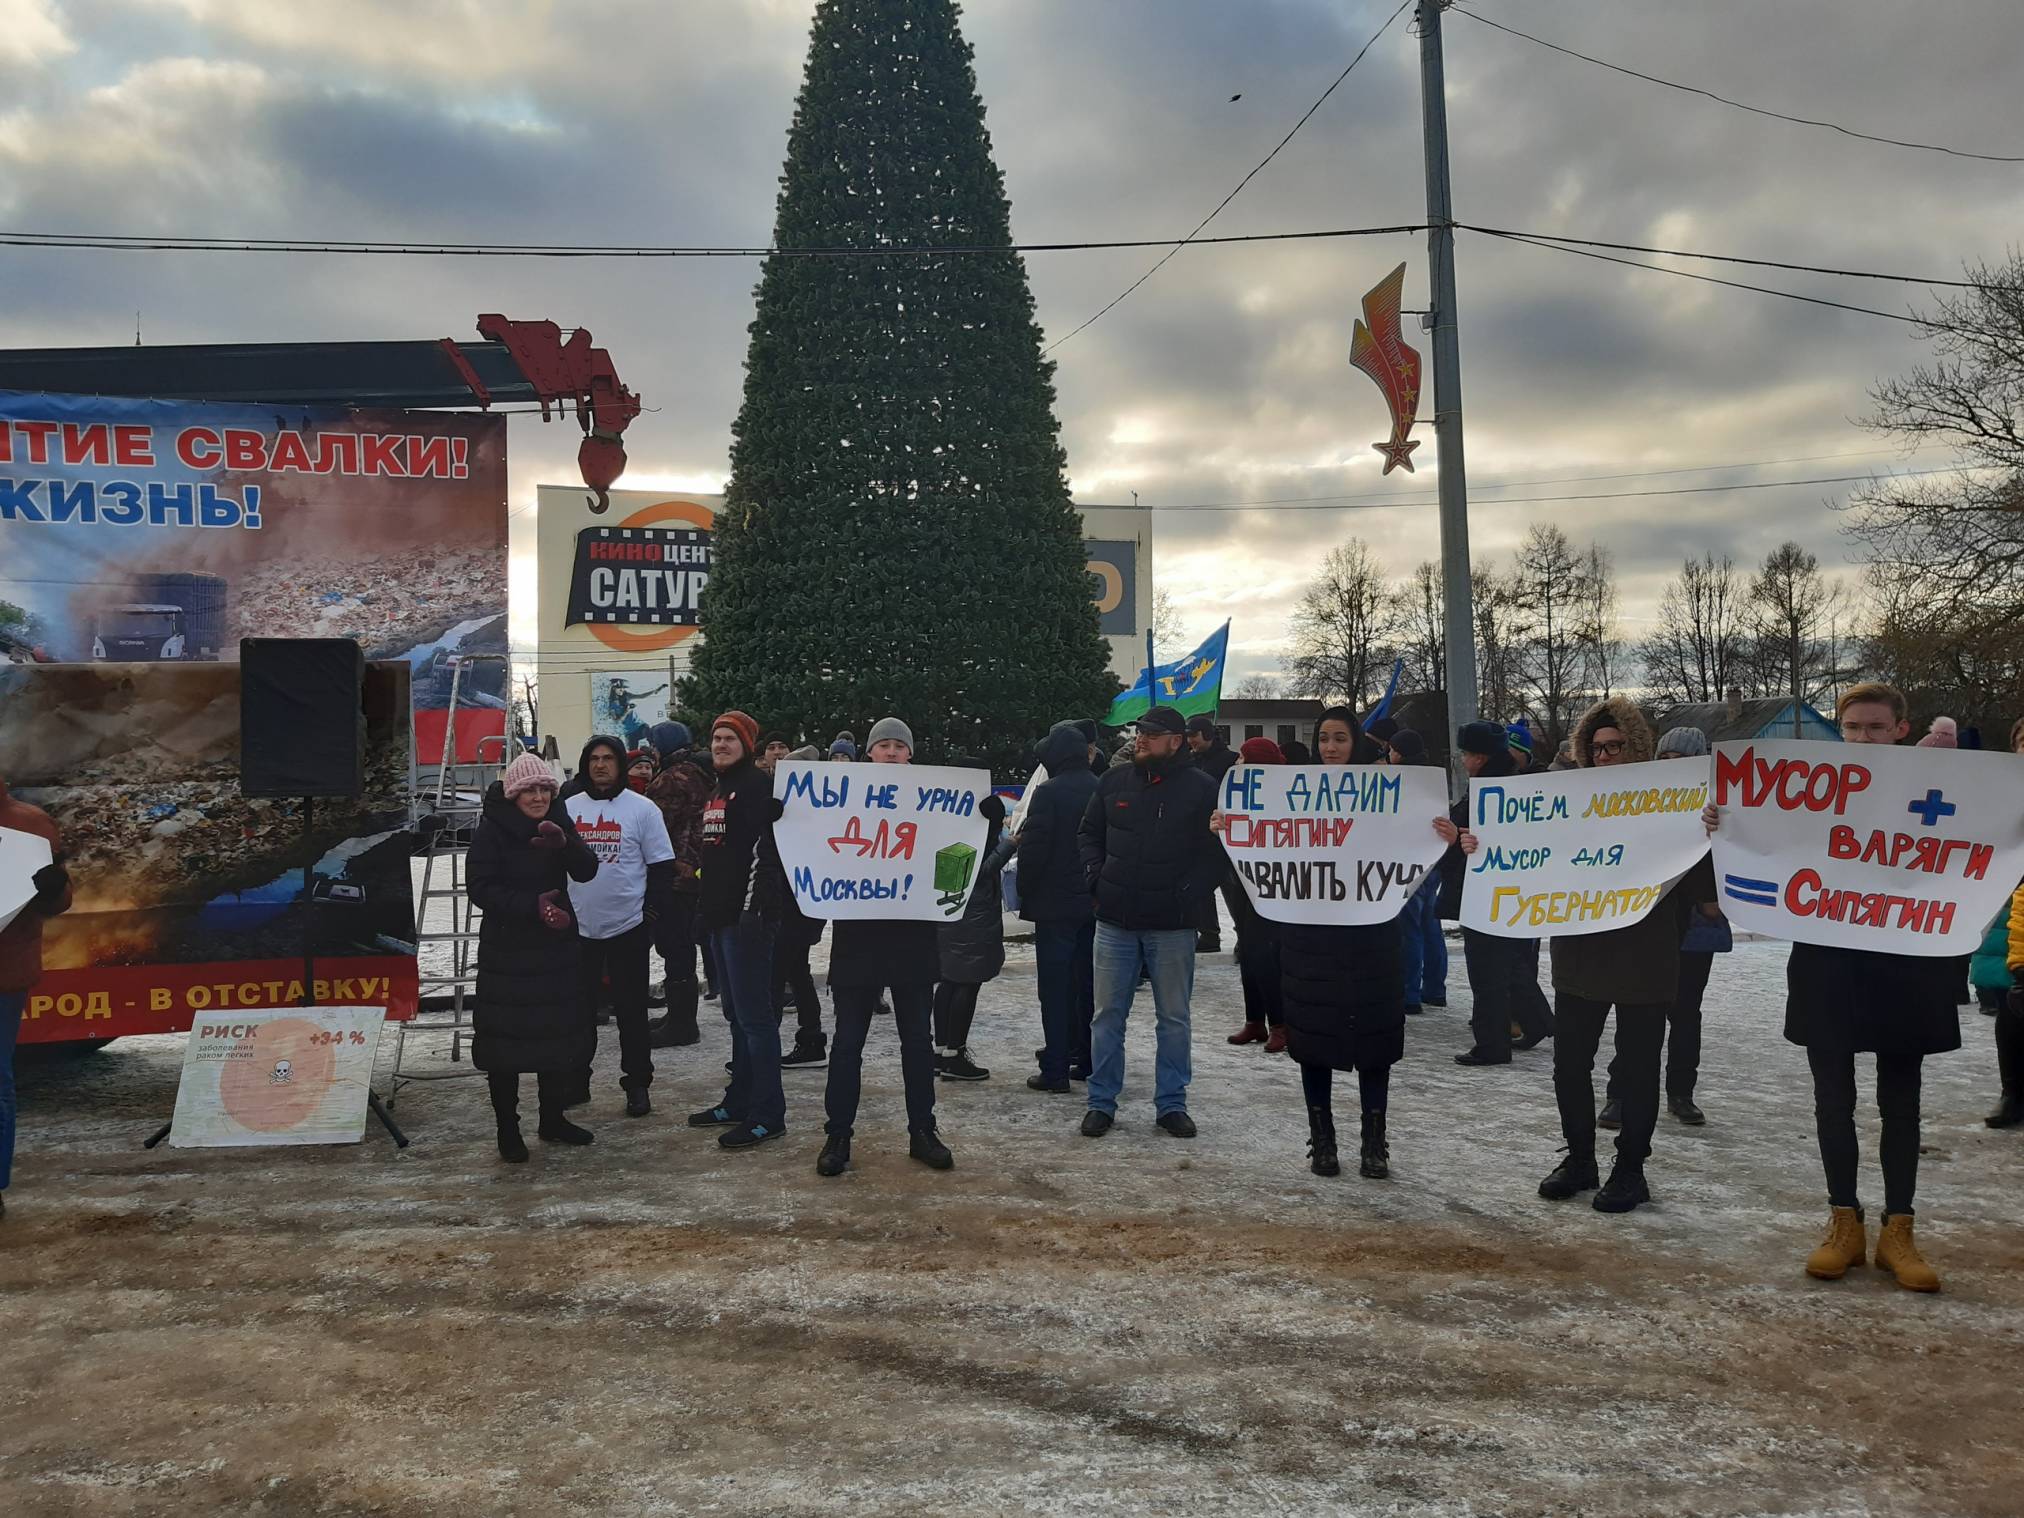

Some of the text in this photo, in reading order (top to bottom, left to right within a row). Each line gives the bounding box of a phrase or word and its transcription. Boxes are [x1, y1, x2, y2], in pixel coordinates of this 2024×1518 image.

[0, 420, 470, 480] ТИЕ СВАЛКИ!
[864, 784, 899, 810] НЕ
[917, 786, 976, 817] УРНА
[1226, 768, 1402, 814] НЕ ДАДИМ
[827, 815, 918, 861] ДЛЯ
[1827, 824, 1995, 881] ВАРЯГИ
[21, 991, 112, 1020] РОД
[150, 988, 173, 1011] В
[186, 976, 391, 1009] ОТСТАВКУ!
[200, 1024, 260, 1039] РИСК
[349, 1030, 366, 1046] %
